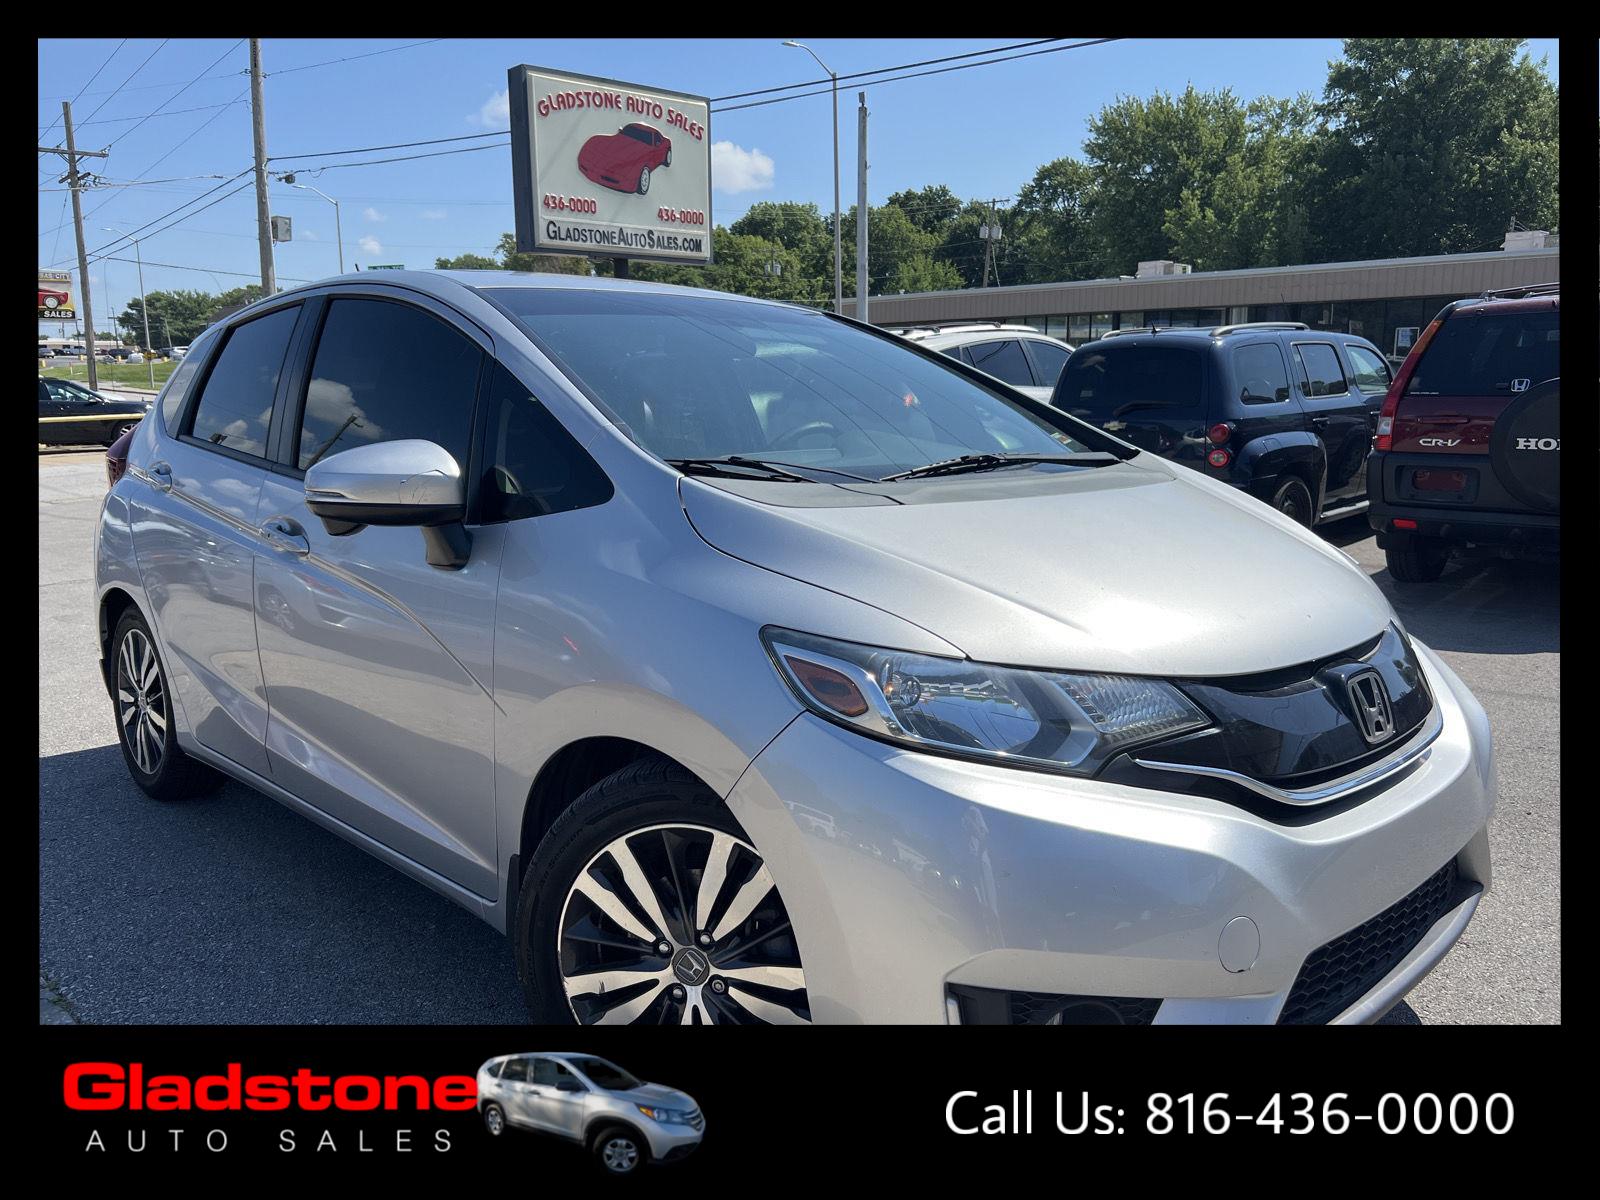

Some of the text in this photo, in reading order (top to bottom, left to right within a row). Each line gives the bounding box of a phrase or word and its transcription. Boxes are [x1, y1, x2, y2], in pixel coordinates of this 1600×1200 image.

[538, 92, 704, 141] GLADSTONE AUTO SALES
[543, 194, 597, 214] 436-0000
[657, 206, 704, 225] 436-0000
[1418, 438, 1462, 447] CR-V
